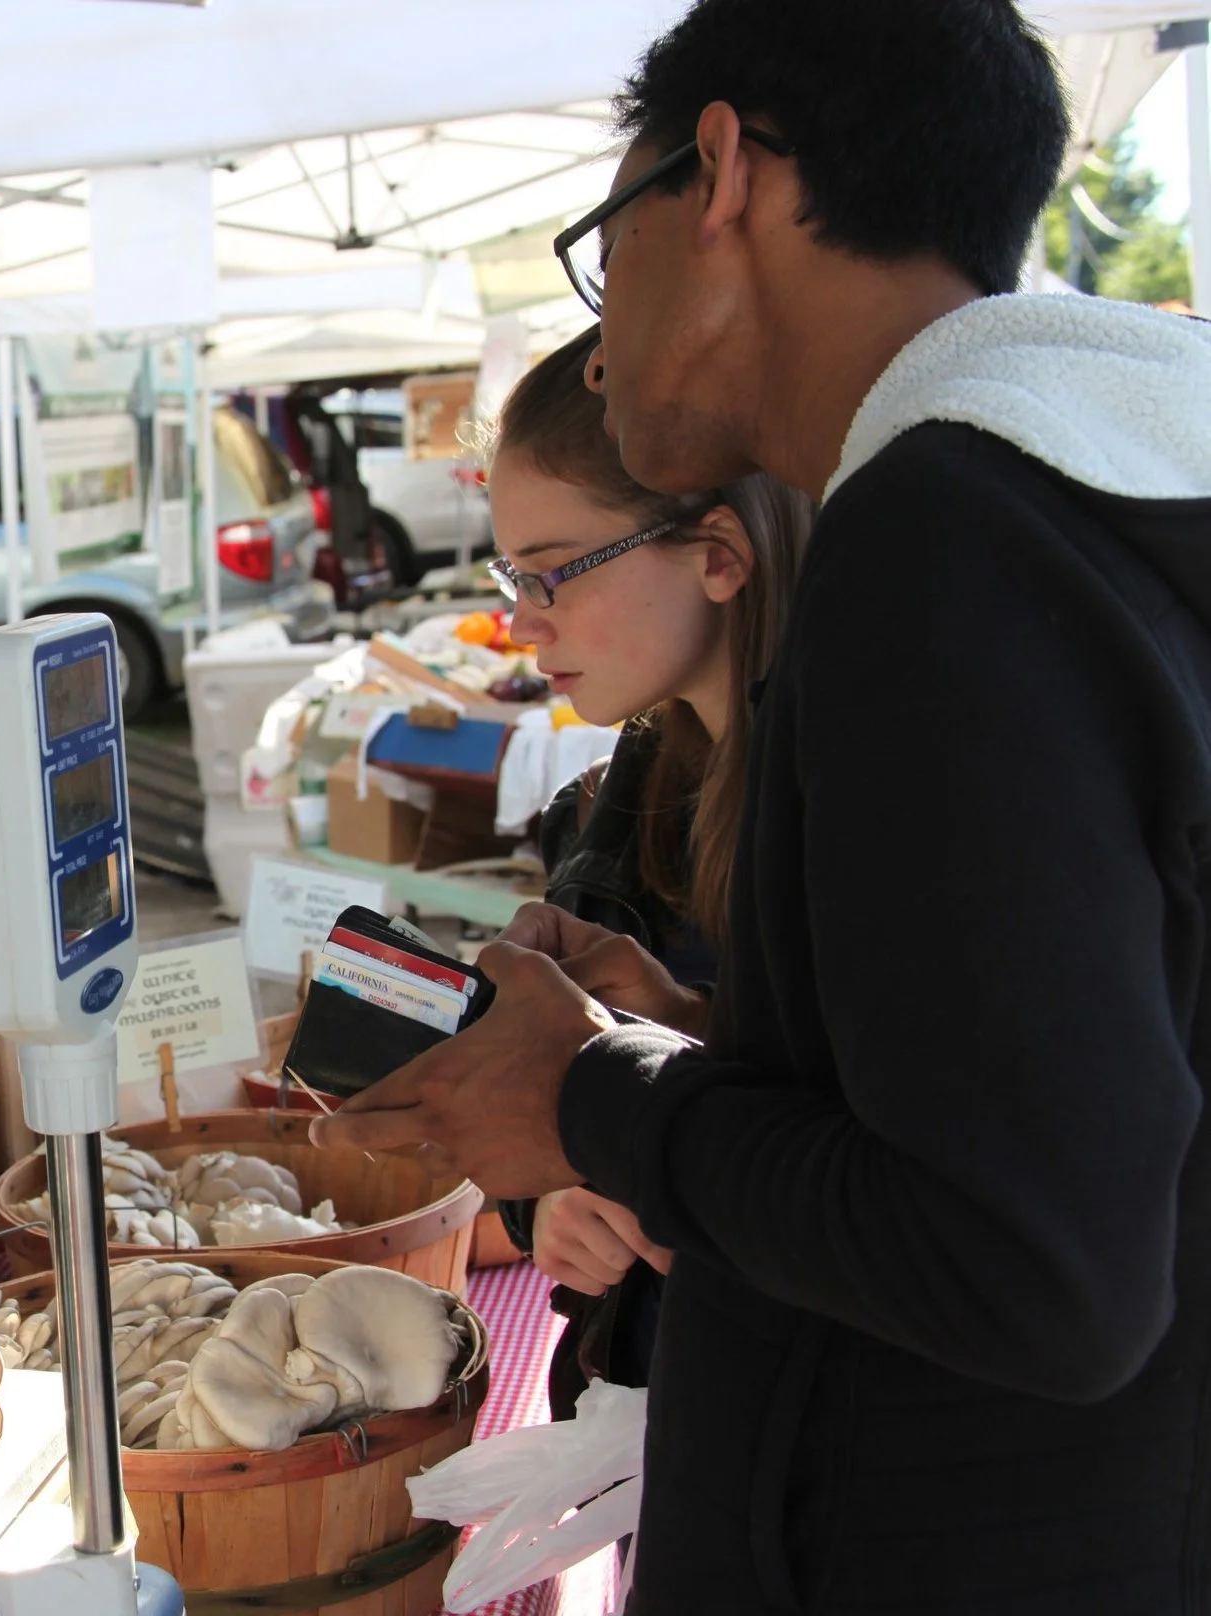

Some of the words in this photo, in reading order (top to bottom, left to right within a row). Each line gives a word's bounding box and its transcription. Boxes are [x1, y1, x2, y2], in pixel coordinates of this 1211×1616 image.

[142, 969, 197, 989] WHITE
[328, 963, 391, 993] CALIFORNIA
[141, 985, 202, 1006] OYSTER
[119, 997, 222, 1027] MUSHROOMS
